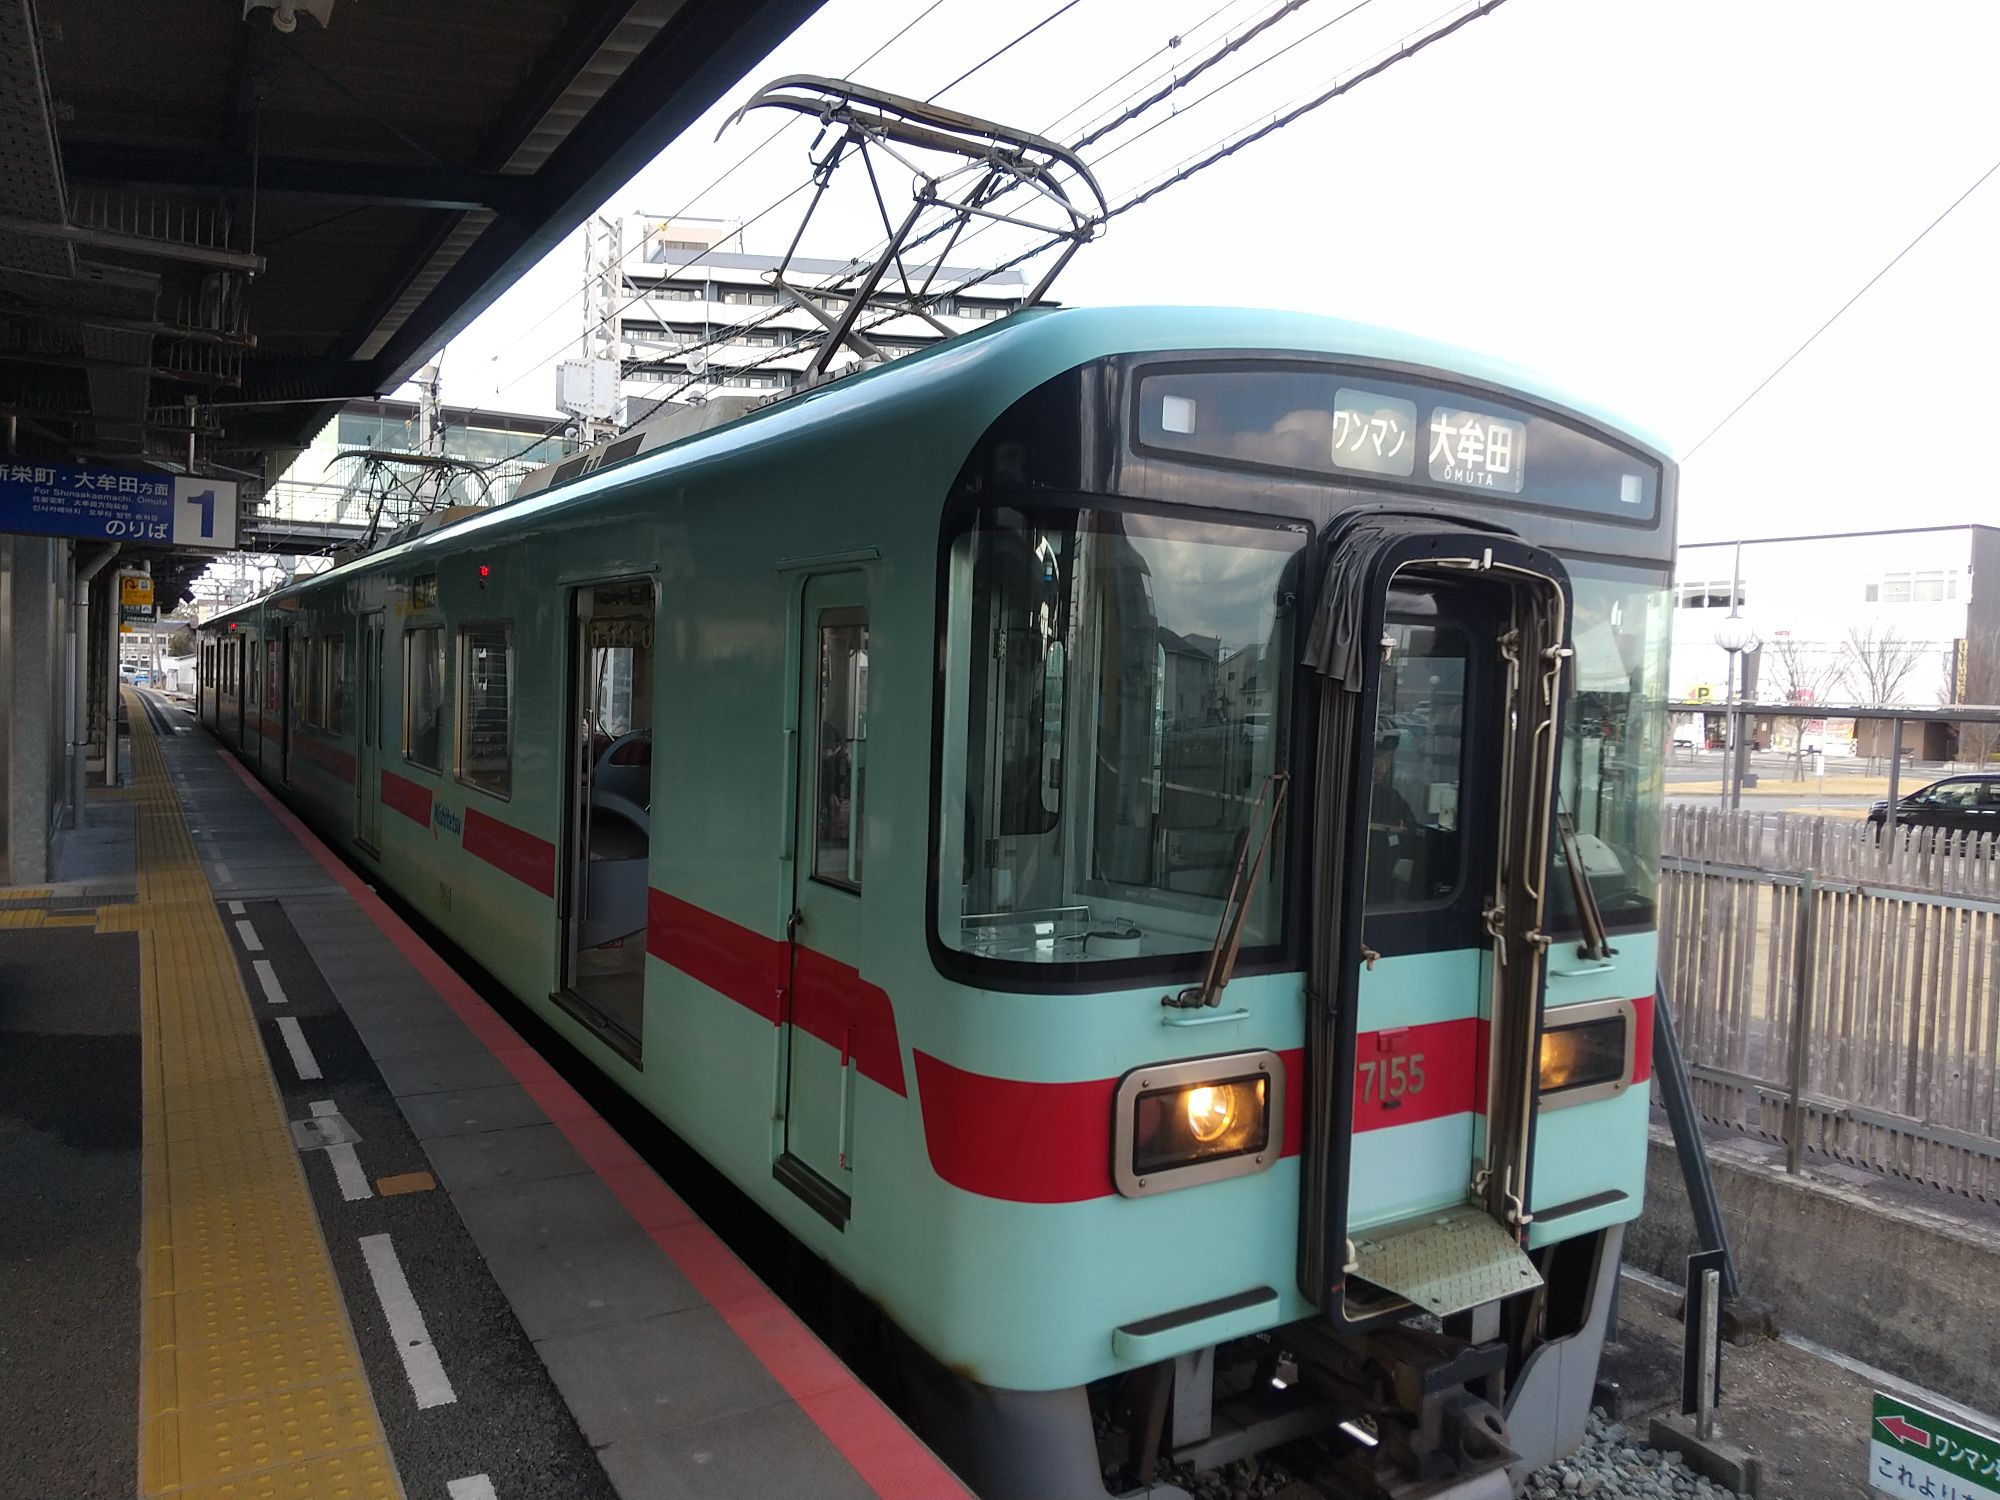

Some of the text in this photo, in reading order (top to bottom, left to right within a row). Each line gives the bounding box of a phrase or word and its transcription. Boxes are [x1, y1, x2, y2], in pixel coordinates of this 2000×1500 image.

[1334, 411, 1512, 474] ワンマン 大牟田
[34, 487, 50, 495] For
[106, 520, 168, 539] のりば
[187, 490, 215, 538] 1
[1698, 687, 1710, 700] P
[1359, 1053, 1424, 1104] 7155
